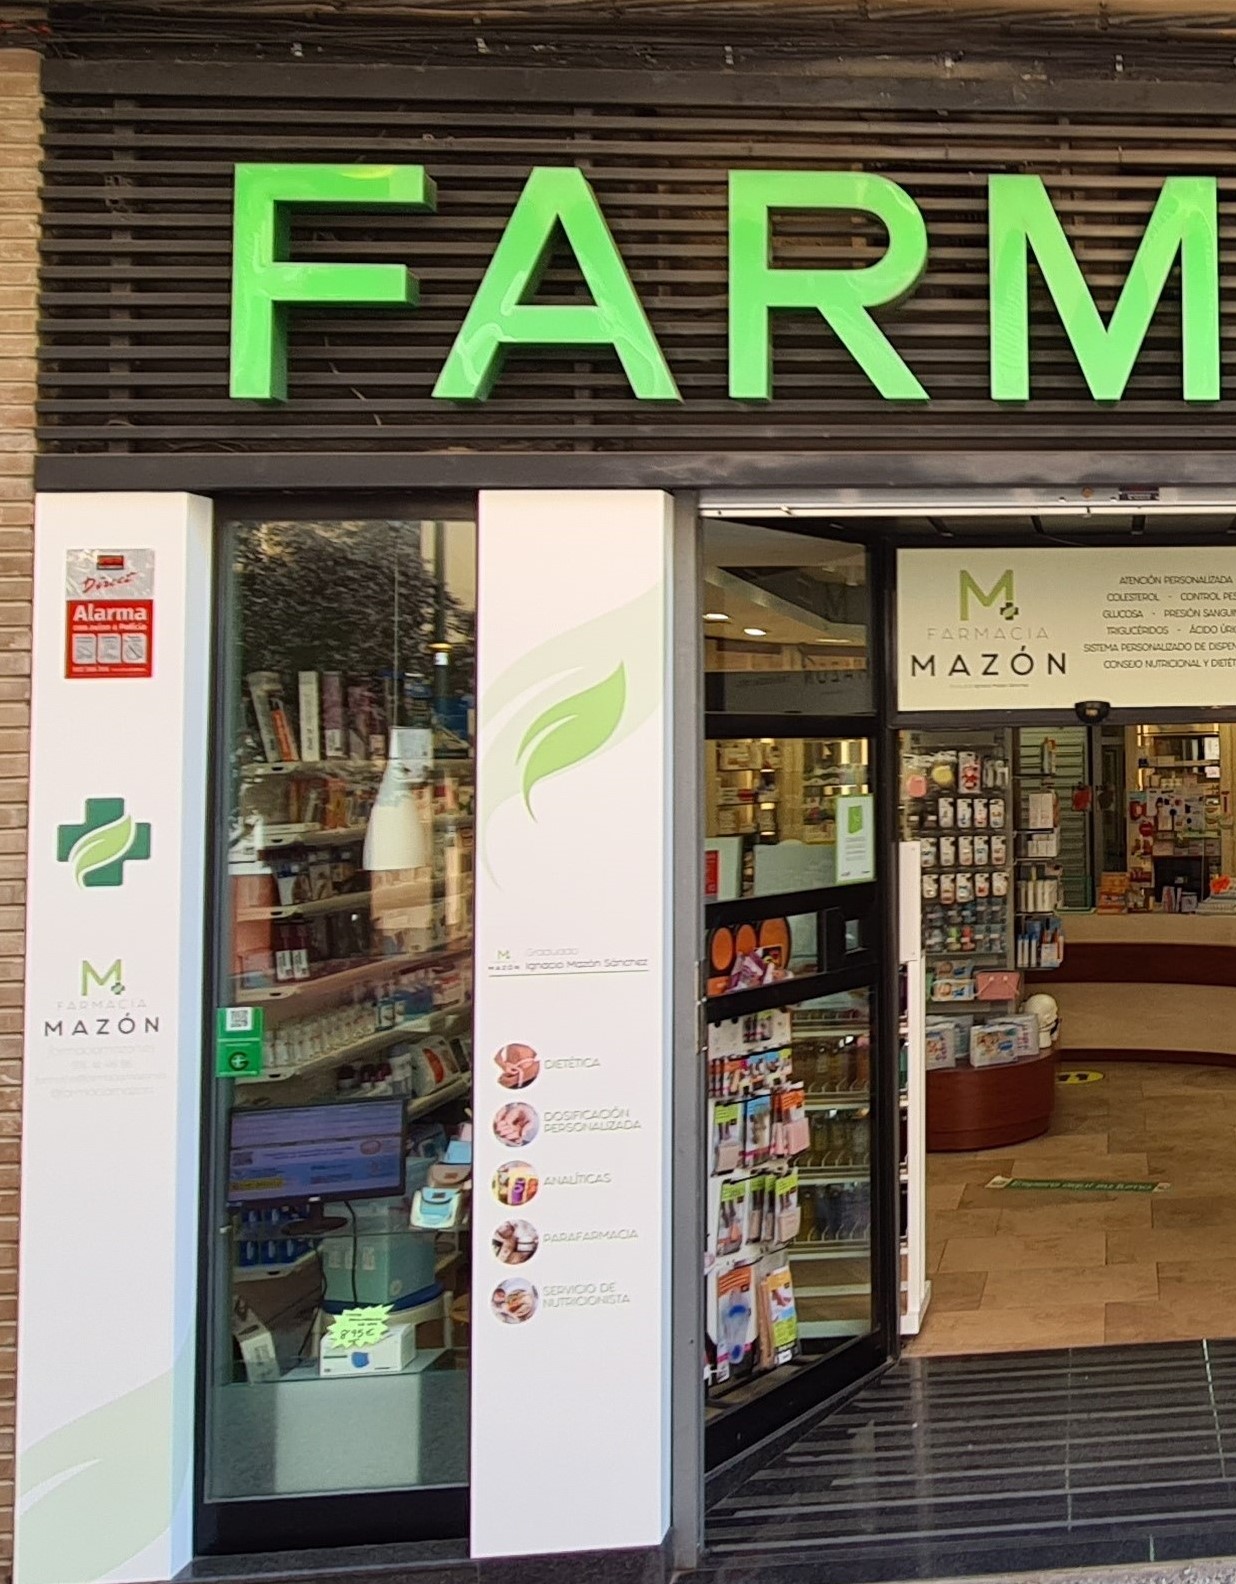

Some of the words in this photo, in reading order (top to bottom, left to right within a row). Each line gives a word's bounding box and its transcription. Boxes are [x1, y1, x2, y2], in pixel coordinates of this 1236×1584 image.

[1119, 575, 1162, 585] ATENCIÓN
[1164, 575, 1233, 584] PERSONALIZADA
[1106, 592, 1160, 601] COLESTEROL
[1180, 592, 1221, 601] CONTROL
[73, 603, 148, 621] Alarma
[1103, 609, 1143, 619] GLUCOSA
[1164, 607, 1201, 617] PRESIÓN
[927, 626, 1050, 641] FARMACIA
[1189, 624, 1218, 634] ÁCIDO
[1083, 643, 1119, 652] SISTEMA
[1121, 642, 1192, 651] PERSONALIZADO
[1194, 642, 1206, 651] DE
[911, 645, 1067, 677] MAZÓN
[1103, 659, 1143, 669] CONSEJO
[1145, 658, 1201, 668] NUTRICIONAL
[1202, 659, 1209, 668] Y
[57, 999, 147, 1011] FARMACIA
[44, 1012, 160, 1037] MAZÓN
[544, 1056, 601, 1069] DIETÉTICA
[544, 1106, 630, 1121] DOSIFICACIÓN
[544, 1120, 642, 1134] PERSONALIZADA
[544, 1170, 612, 1186] ANALÍTICAS
[542, 1229, 639, 1244] PARAFARMACIA
[542, 1283, 597, 1297] SERVICIO
[599, 1282, 616, 1294] DE
[542, 1293, 631, 1308] NUTRICIONISTA
